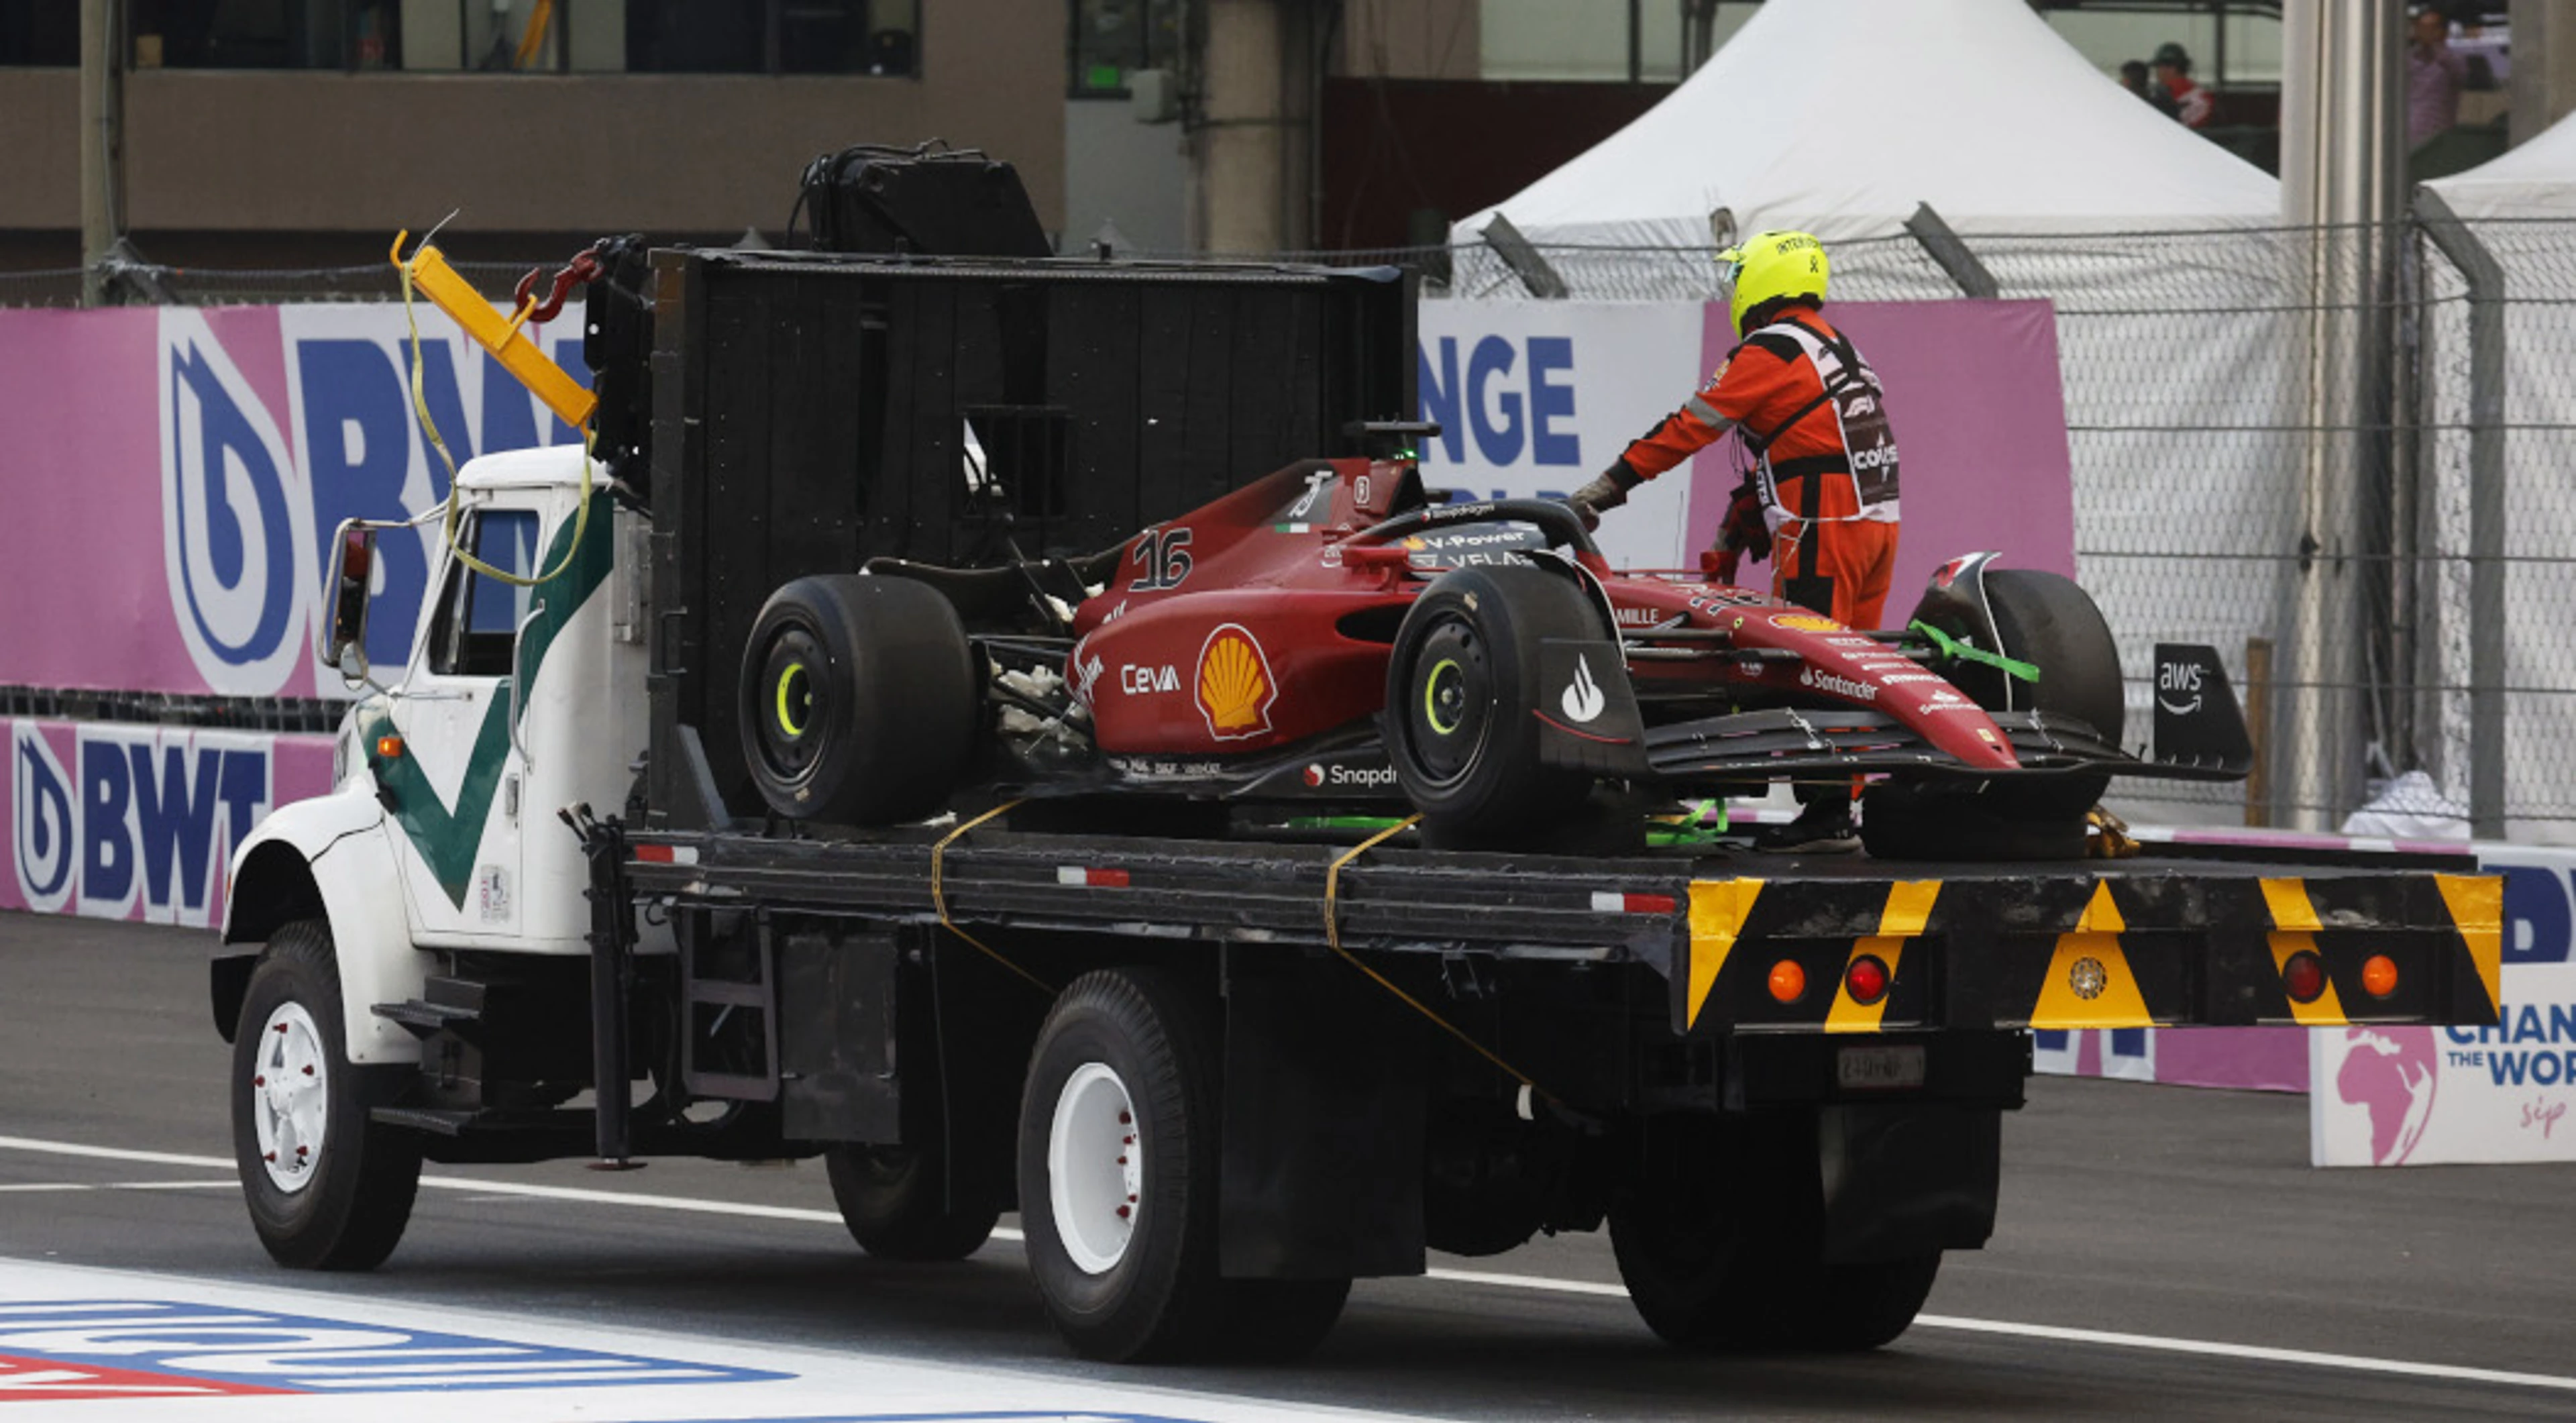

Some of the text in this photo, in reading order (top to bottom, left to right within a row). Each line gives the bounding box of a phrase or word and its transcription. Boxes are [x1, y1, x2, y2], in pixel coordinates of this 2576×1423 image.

[1425, 532, 1525, 549] V-Power
[1128, 527, 1193, 592] 16
[1617, 608, 1659, 625] MILLE
[1814, 669, 1880, 700] Santander
[2161, 662, 2202, 691] aws
[83, 739, 266, 909] BWT
[2447, 1051, 2483, 1067] THE
